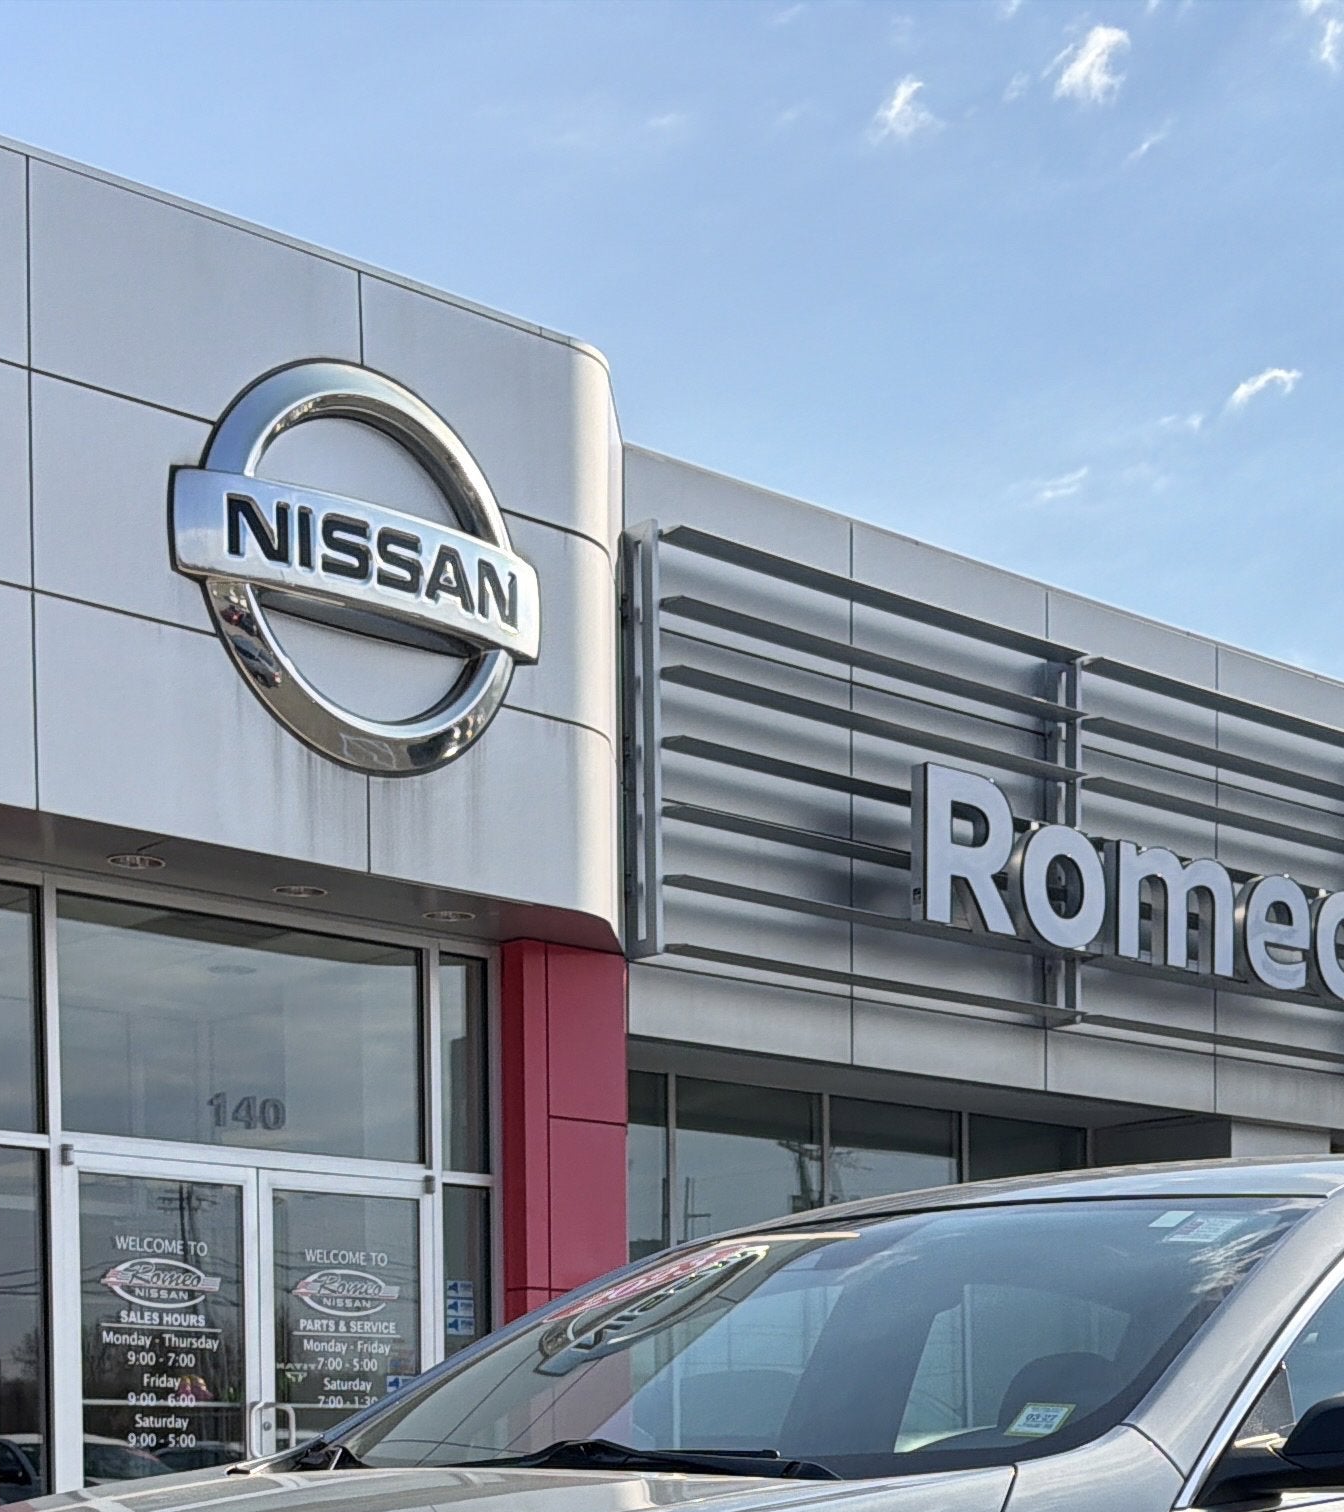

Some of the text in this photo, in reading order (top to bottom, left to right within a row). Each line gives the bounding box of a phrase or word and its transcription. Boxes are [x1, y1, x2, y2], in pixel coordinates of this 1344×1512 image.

[225, 493, 519, 634] NISSAN
[207, 1092, 287, 1130] 140
[115, 1235, 208, 1257] WELCOME TO
[304, 1248, 388, 1267] WELCOME TO
[124, 1261, 203, 1287] Romeo
[135, 1287, 189, 1301] NISSAN
[316, 1275, 383, 1297] Romeo
[322, 1297, 372, 1308] NISSAN
[120, 1310, 206, 1327] SALES HOURS
[299, 1318, 396, 1334] PARTS & SERVICE
[102, 1330, 152, 1348] Monday
[162, 1333, 219, 1352] Thursday
[303, 1339, 348, 1355] Monday
[357, 1341, 391, 1356] Friday
[127, 1351, 156, 1366] 9:00
[167, 1352, 196, 1367] 7:00
[317, 1357, 343, 1371] 7:00
[353, 1359, 378, 1371] 5:00
[143, 1373, 181, 1390] Friday
[323, 1377, 373, 1393] Saturday
[127, 1391, 156, 1406] 9:00
[167, 1393, 196, 1407] 6:00
[317, 1396, 343, 1408] 7:00
[135, 1413, 190, 1431] Saturday
[127, 1432, 156, 1447] 9:00
[168, 1433, 196, 1448] 5:00
